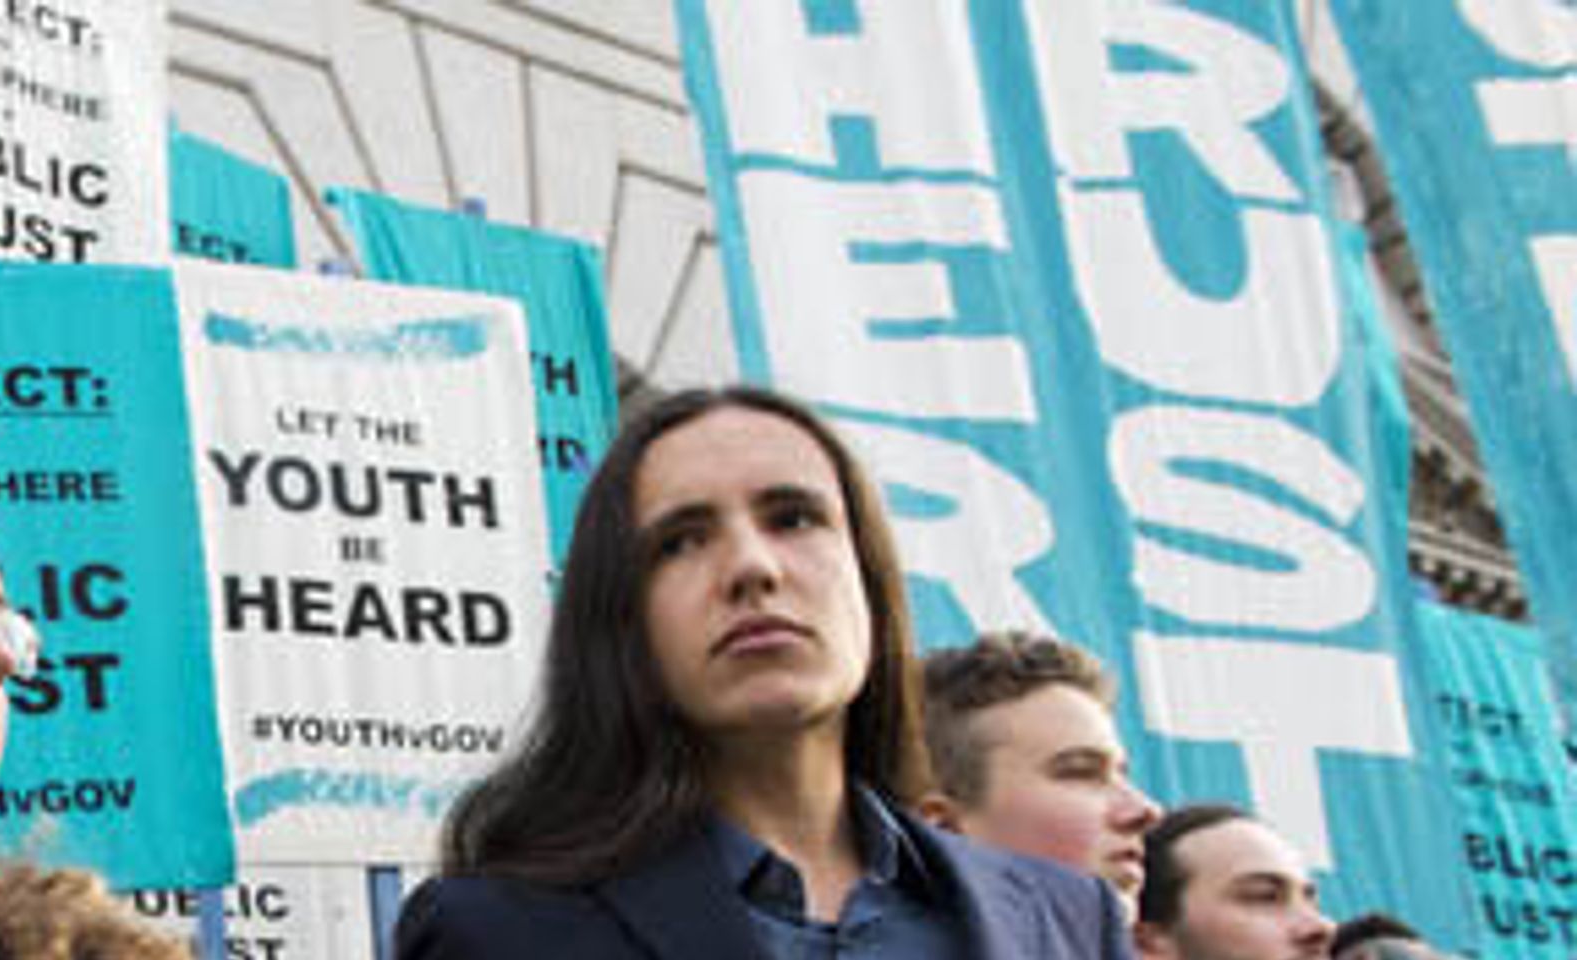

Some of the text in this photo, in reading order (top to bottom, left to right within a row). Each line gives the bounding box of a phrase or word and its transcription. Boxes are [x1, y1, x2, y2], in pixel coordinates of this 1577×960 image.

[275, 407, 422, 445] LET THE
[207, 448, 499, 529] YOUTH
[339, 536, 383, 563] BE
[222, 573, 511, 648] HEARD
[252, 713, 503, 753] #YOUTHvGOV
